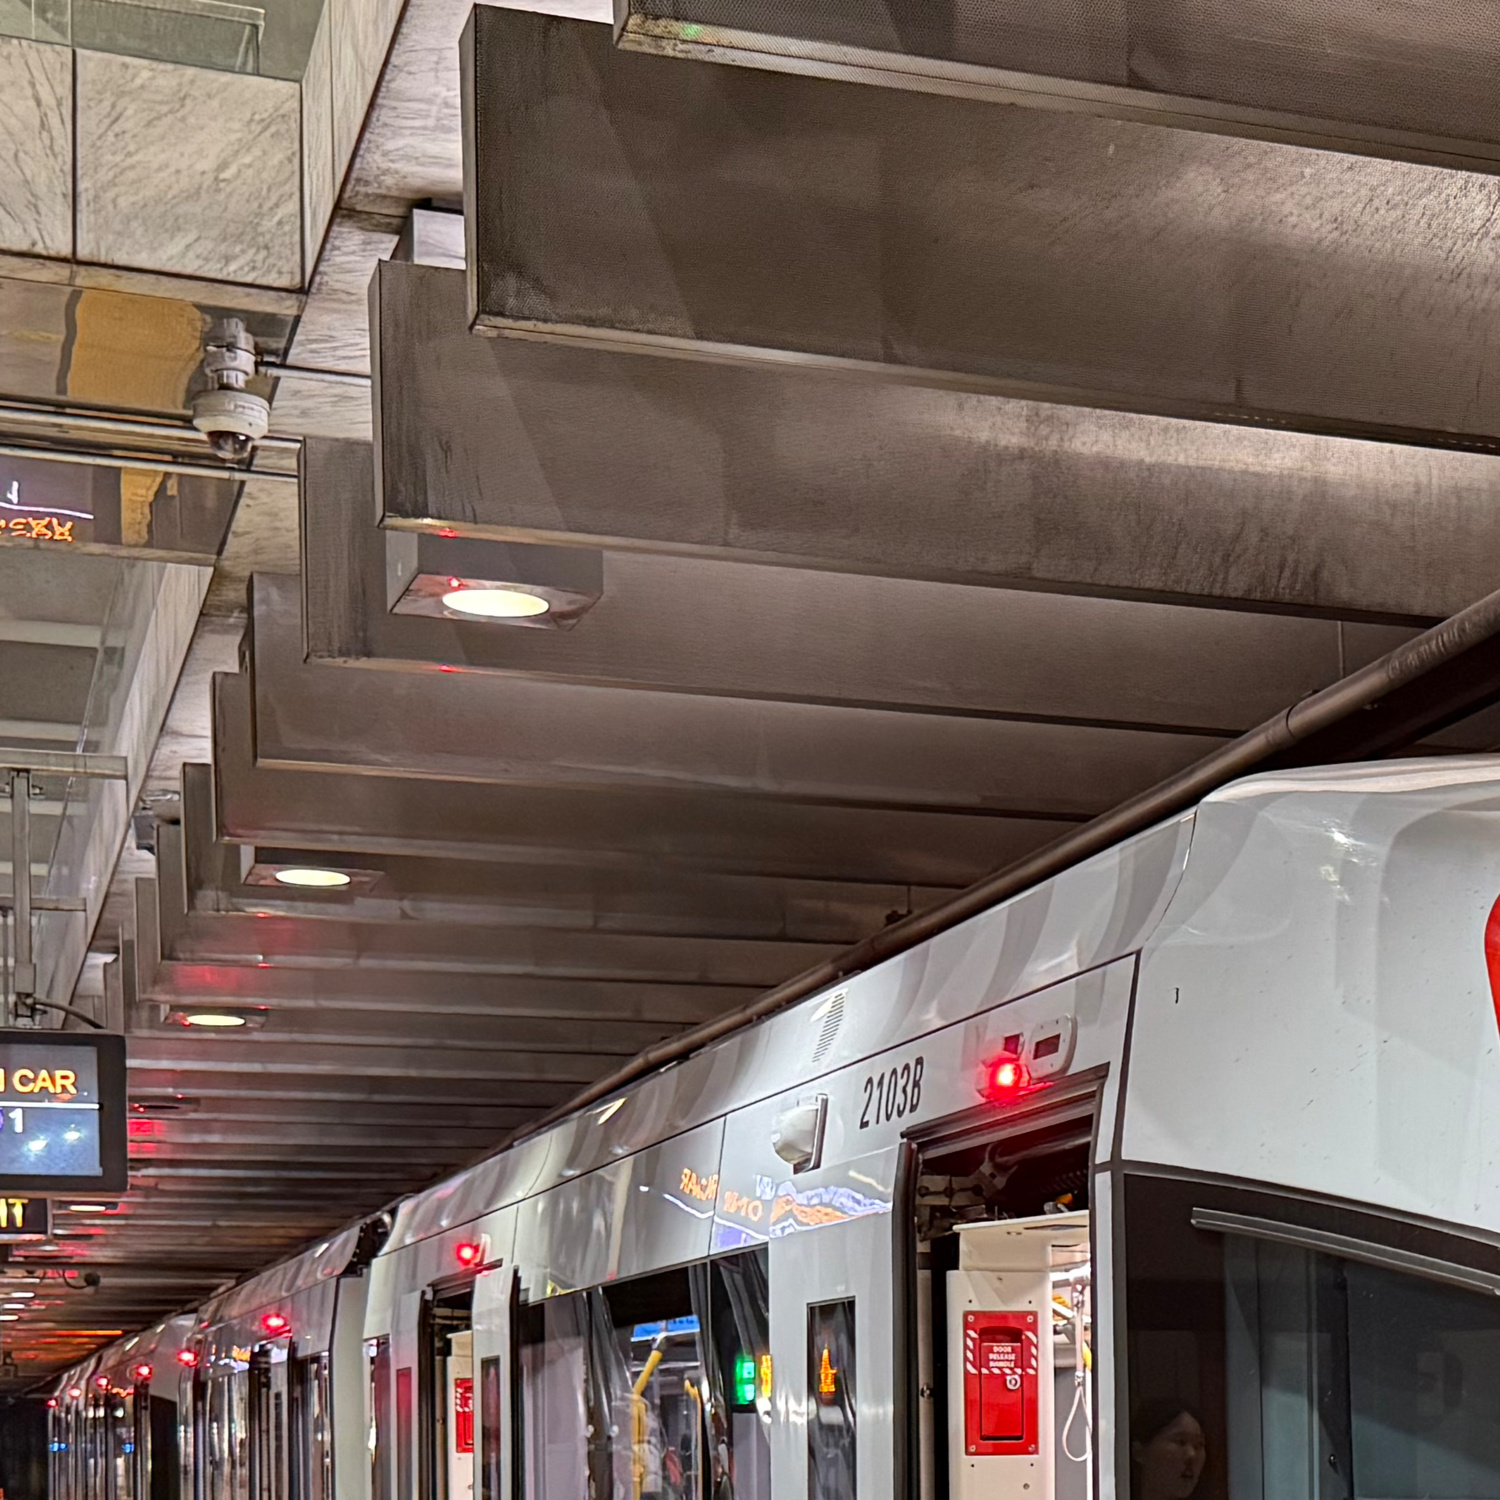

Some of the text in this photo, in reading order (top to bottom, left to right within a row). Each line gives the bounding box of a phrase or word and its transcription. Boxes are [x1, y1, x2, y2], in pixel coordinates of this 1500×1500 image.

[12, 1068, 78, 1095] CAR
[859, 1055, 924, 1130] 2103B
[992, 1345, 1012, 1353] DOOR
